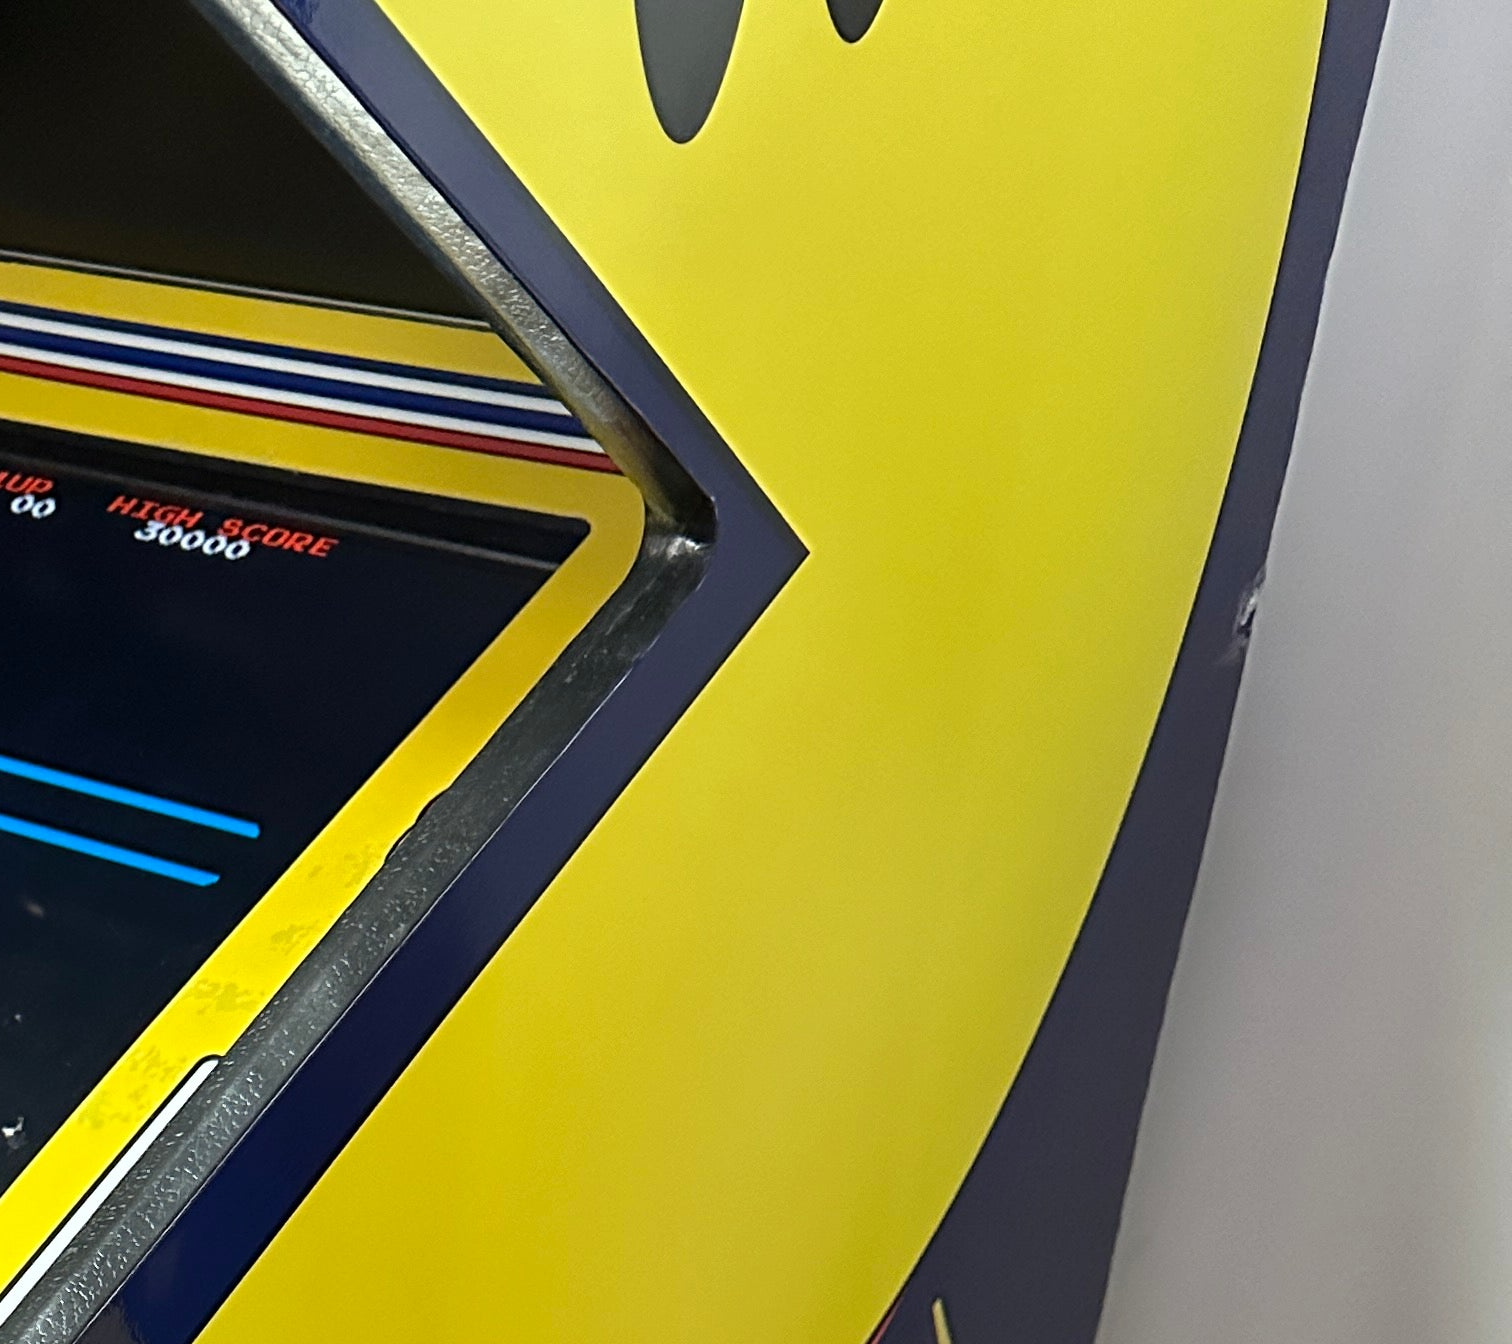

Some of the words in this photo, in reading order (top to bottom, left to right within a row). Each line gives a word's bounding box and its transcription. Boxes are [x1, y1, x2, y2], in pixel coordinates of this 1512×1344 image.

[10, 493, 56, 519] 00
[133, 519, 251, 561] 30000
[106, 495, 205, 530] HIGH
[216, 517, 340, 558] SCORE
